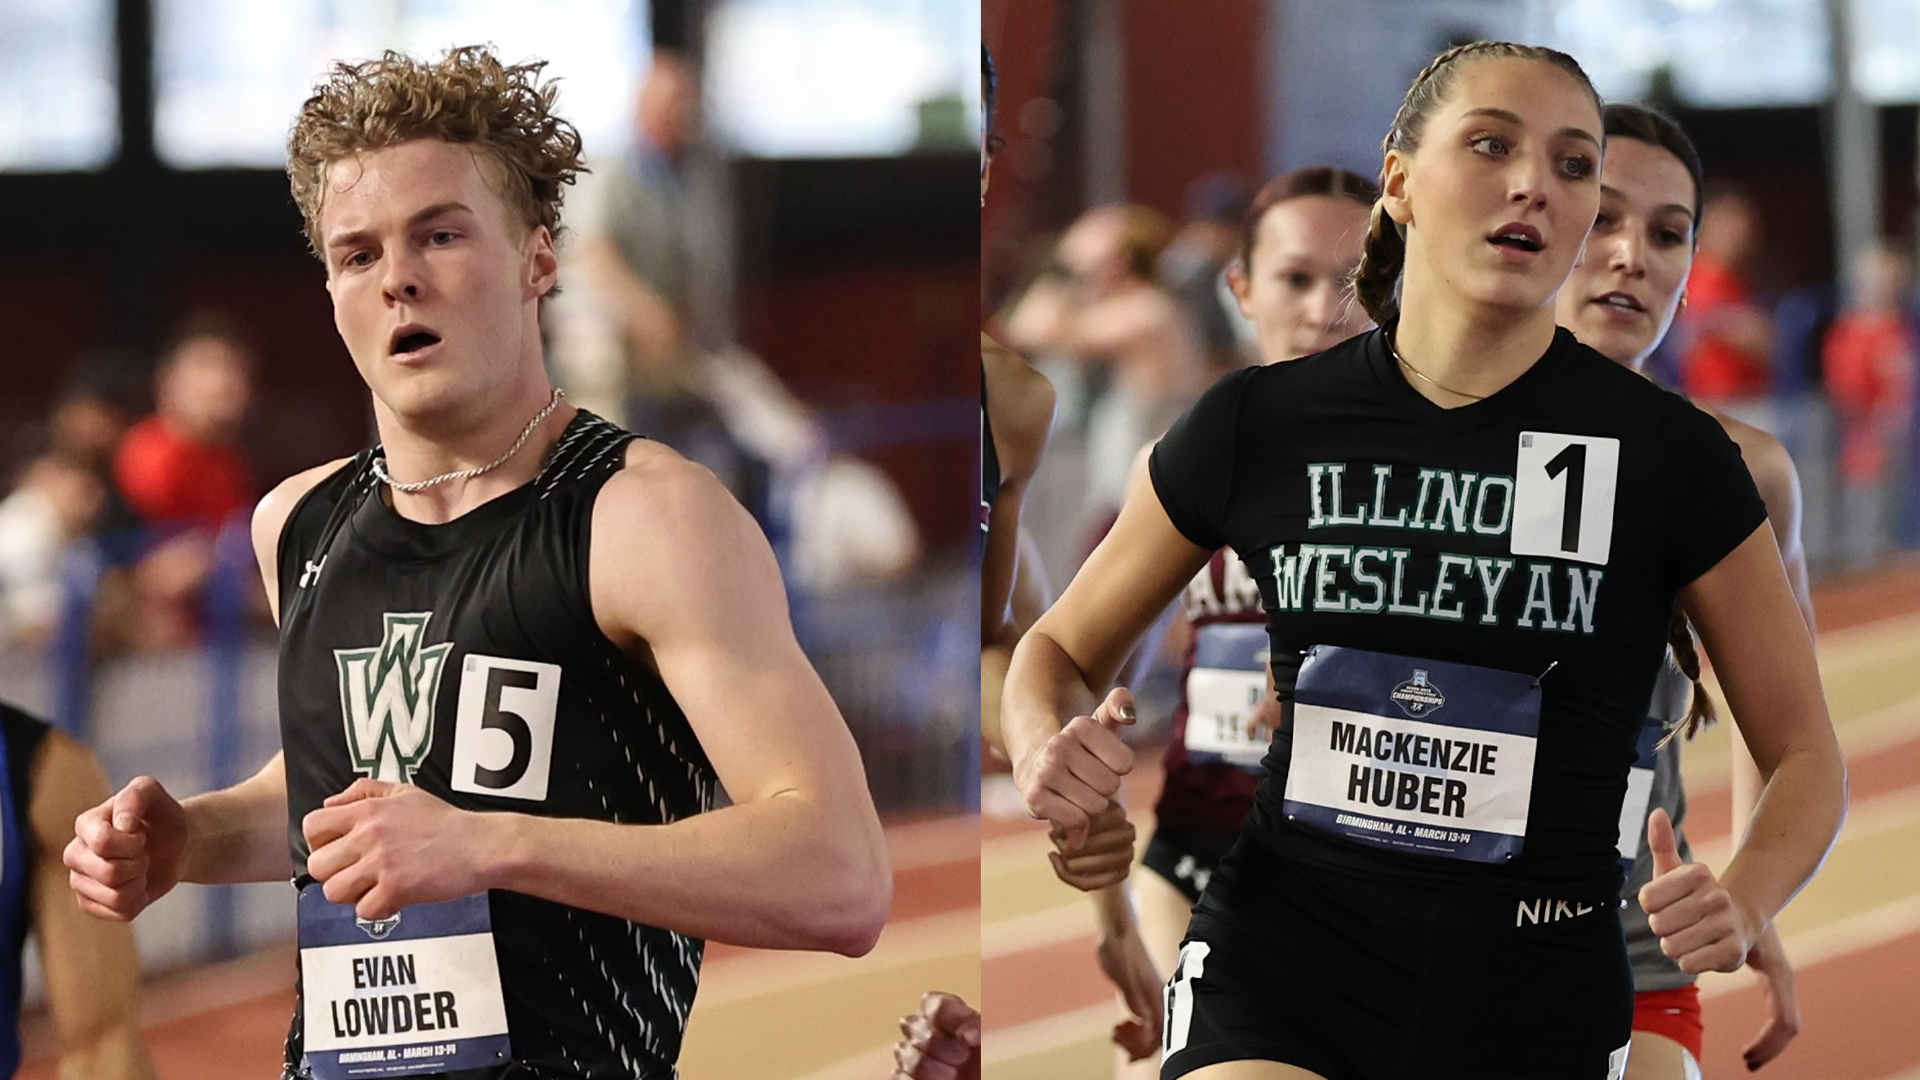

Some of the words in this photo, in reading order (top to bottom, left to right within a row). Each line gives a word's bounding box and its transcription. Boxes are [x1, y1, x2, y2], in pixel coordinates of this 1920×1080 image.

[1307, 463, 1515, 536] ILLINO
[1544, 443, 1587, 554] 1
[1269, 543, 1604, 634] WESLEYAN
[473, 667, 539, 790] 5
[1330, 721, 1498, 775] MACKENZIE
[1347, 764, 1468, 819] HUBER
[1335, 813, 1394, 835] BIRMINGHAM,
[1395, 824, 1407, 835] AL
[1413, 826, 1447, 841] MARCH
[1448, 832, 1471, 844] 13-14
[352, 954, 417, 989] EVAN
[331, 991, 459, 1038] LOWDER
[403, 1046, 433, 1059] MARCH
